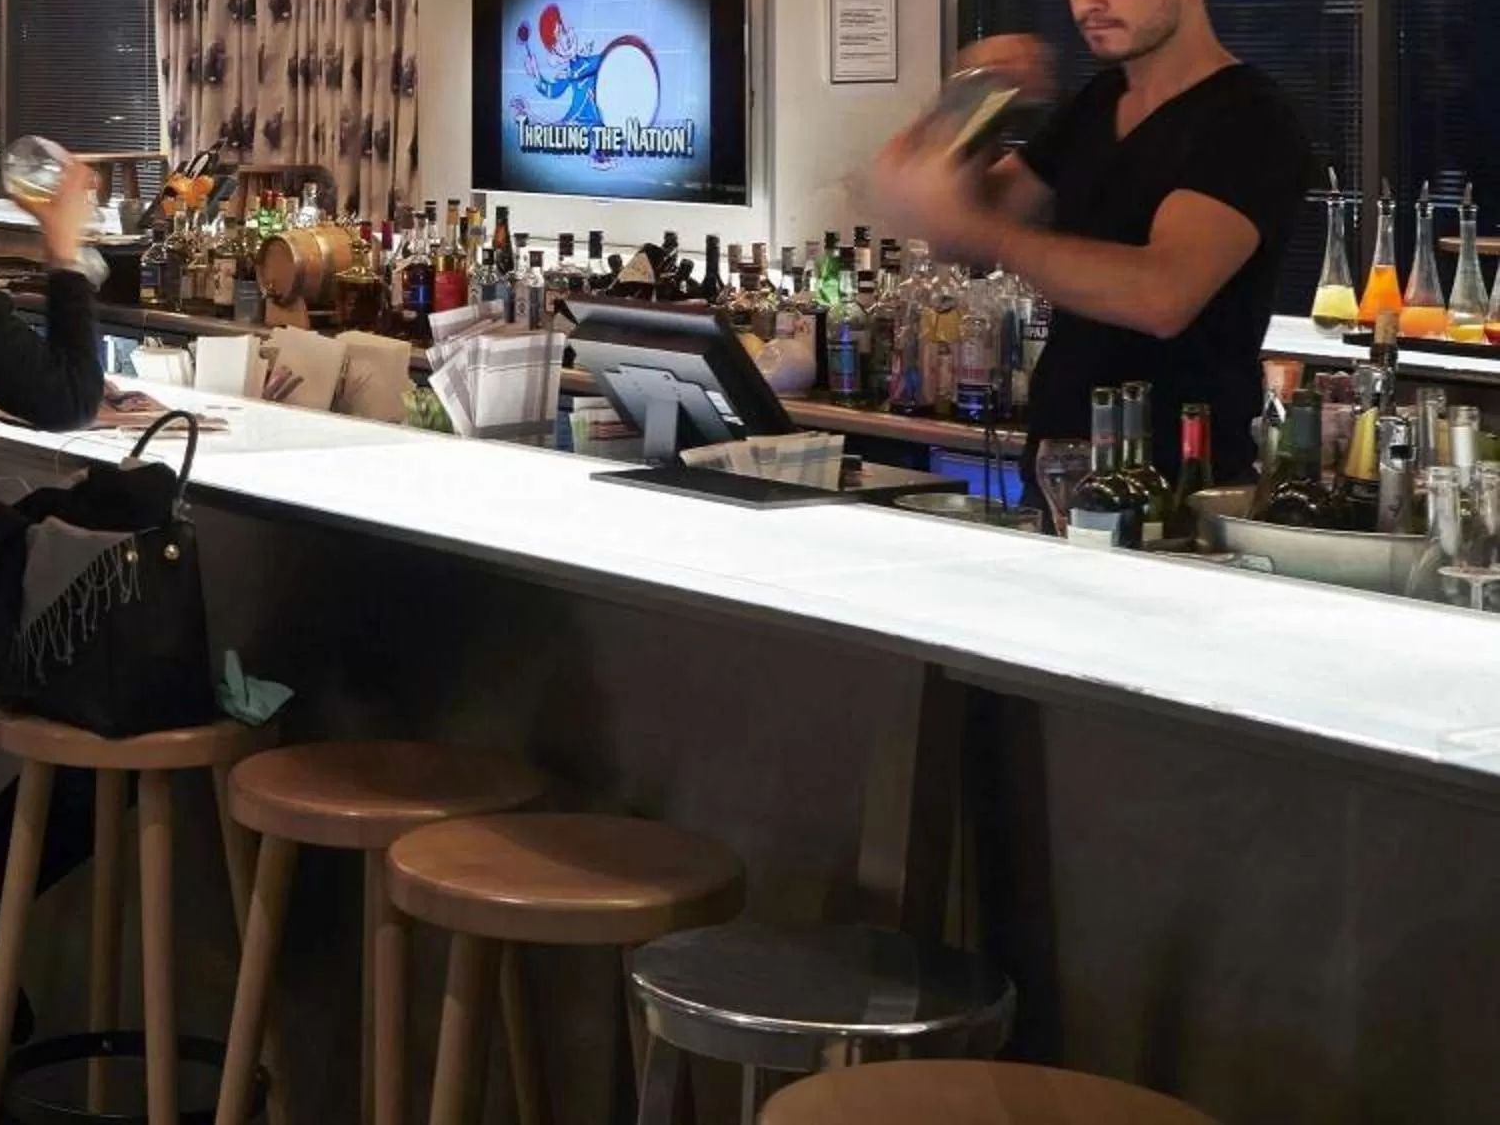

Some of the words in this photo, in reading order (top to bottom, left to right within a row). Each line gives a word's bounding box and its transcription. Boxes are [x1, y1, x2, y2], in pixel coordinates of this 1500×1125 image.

[516, 115, 589, 152] THRILLING
[592, 125, 623, 154] THE
[625, 118, 695, 156] NATION!
